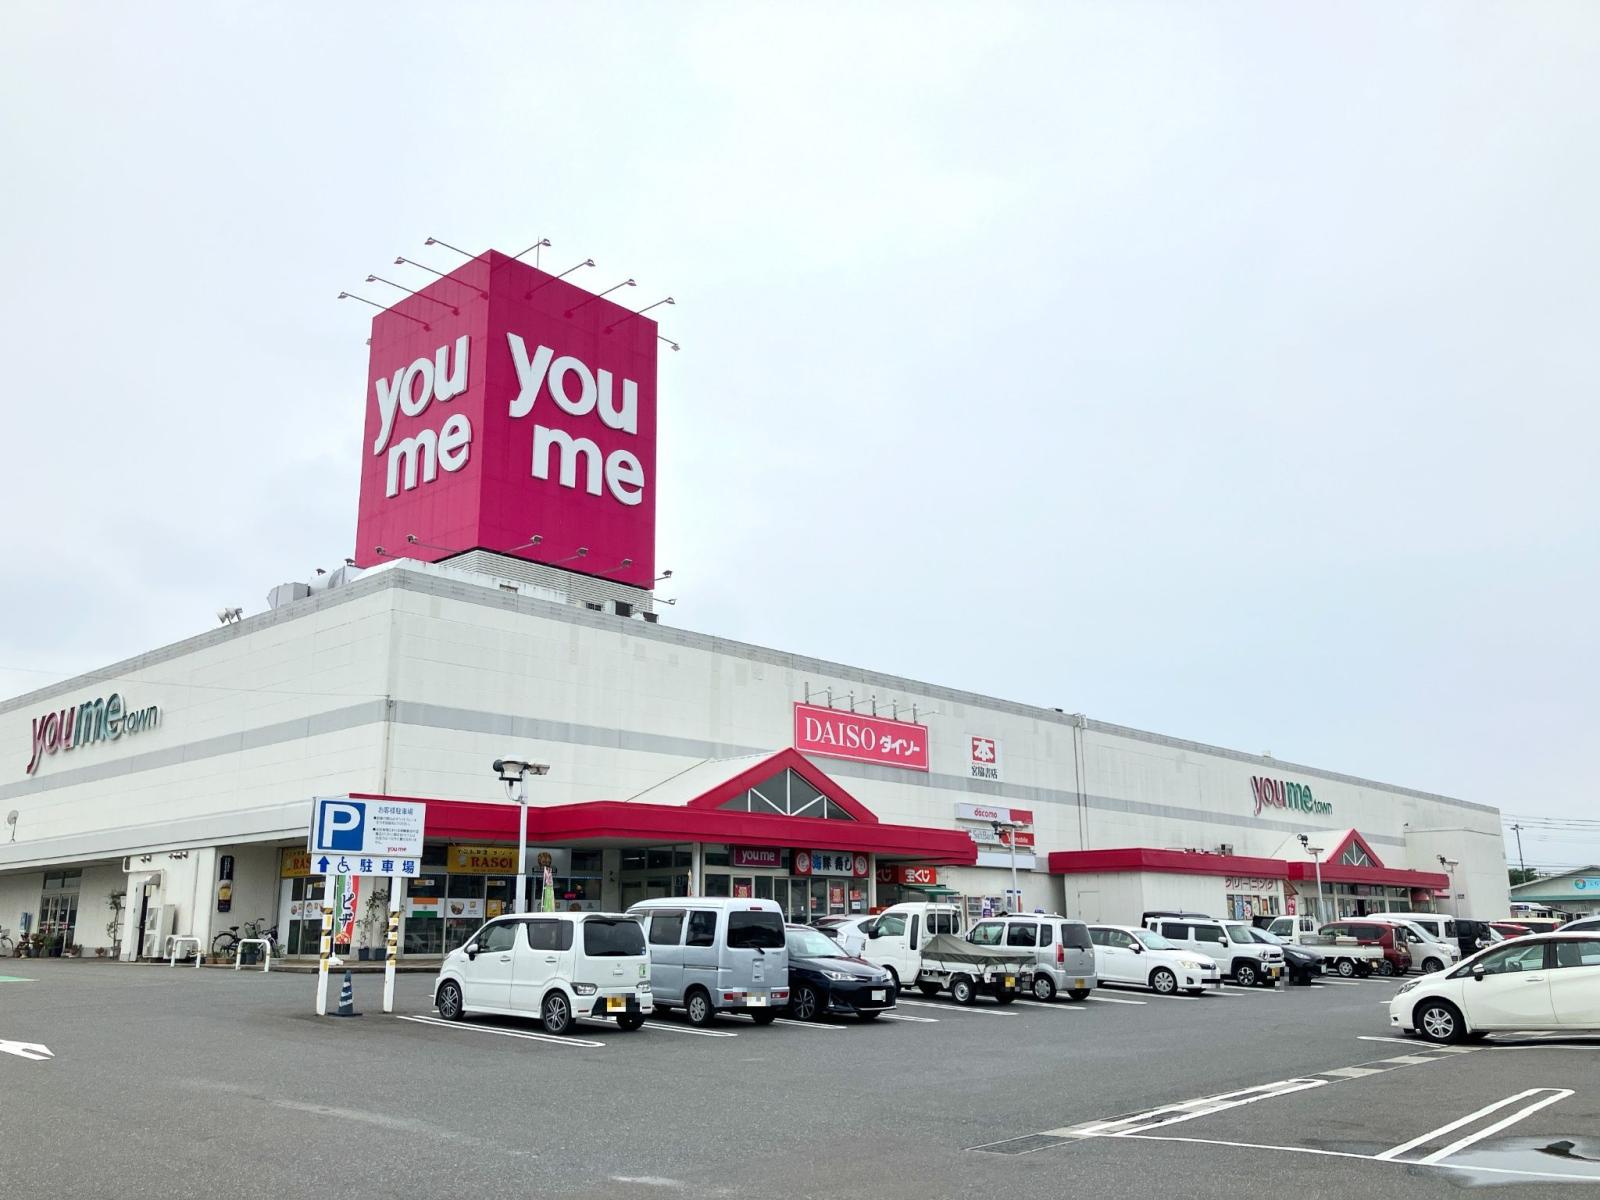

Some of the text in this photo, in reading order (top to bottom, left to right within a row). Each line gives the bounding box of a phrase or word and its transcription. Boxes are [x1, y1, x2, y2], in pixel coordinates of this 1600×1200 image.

[374, 335, 470, 456] you
[507, 332, 638, 435] you
[386, 413, 472, 498] me
[532, 424, 645, 505] me
[804, 717, 920, 756] DAISO ダイソー
[973, 739, 995, 762] 本
[322, 803, 361, 848] P
[974, 808, 998, 819] docomo
[360, 858, 415, 873] 駐車場
[471, 856, 513, 868] RASOI
[905, 869, 931, 883] 宝くじ
[1225, 878, 1274, 890] クリーニング
